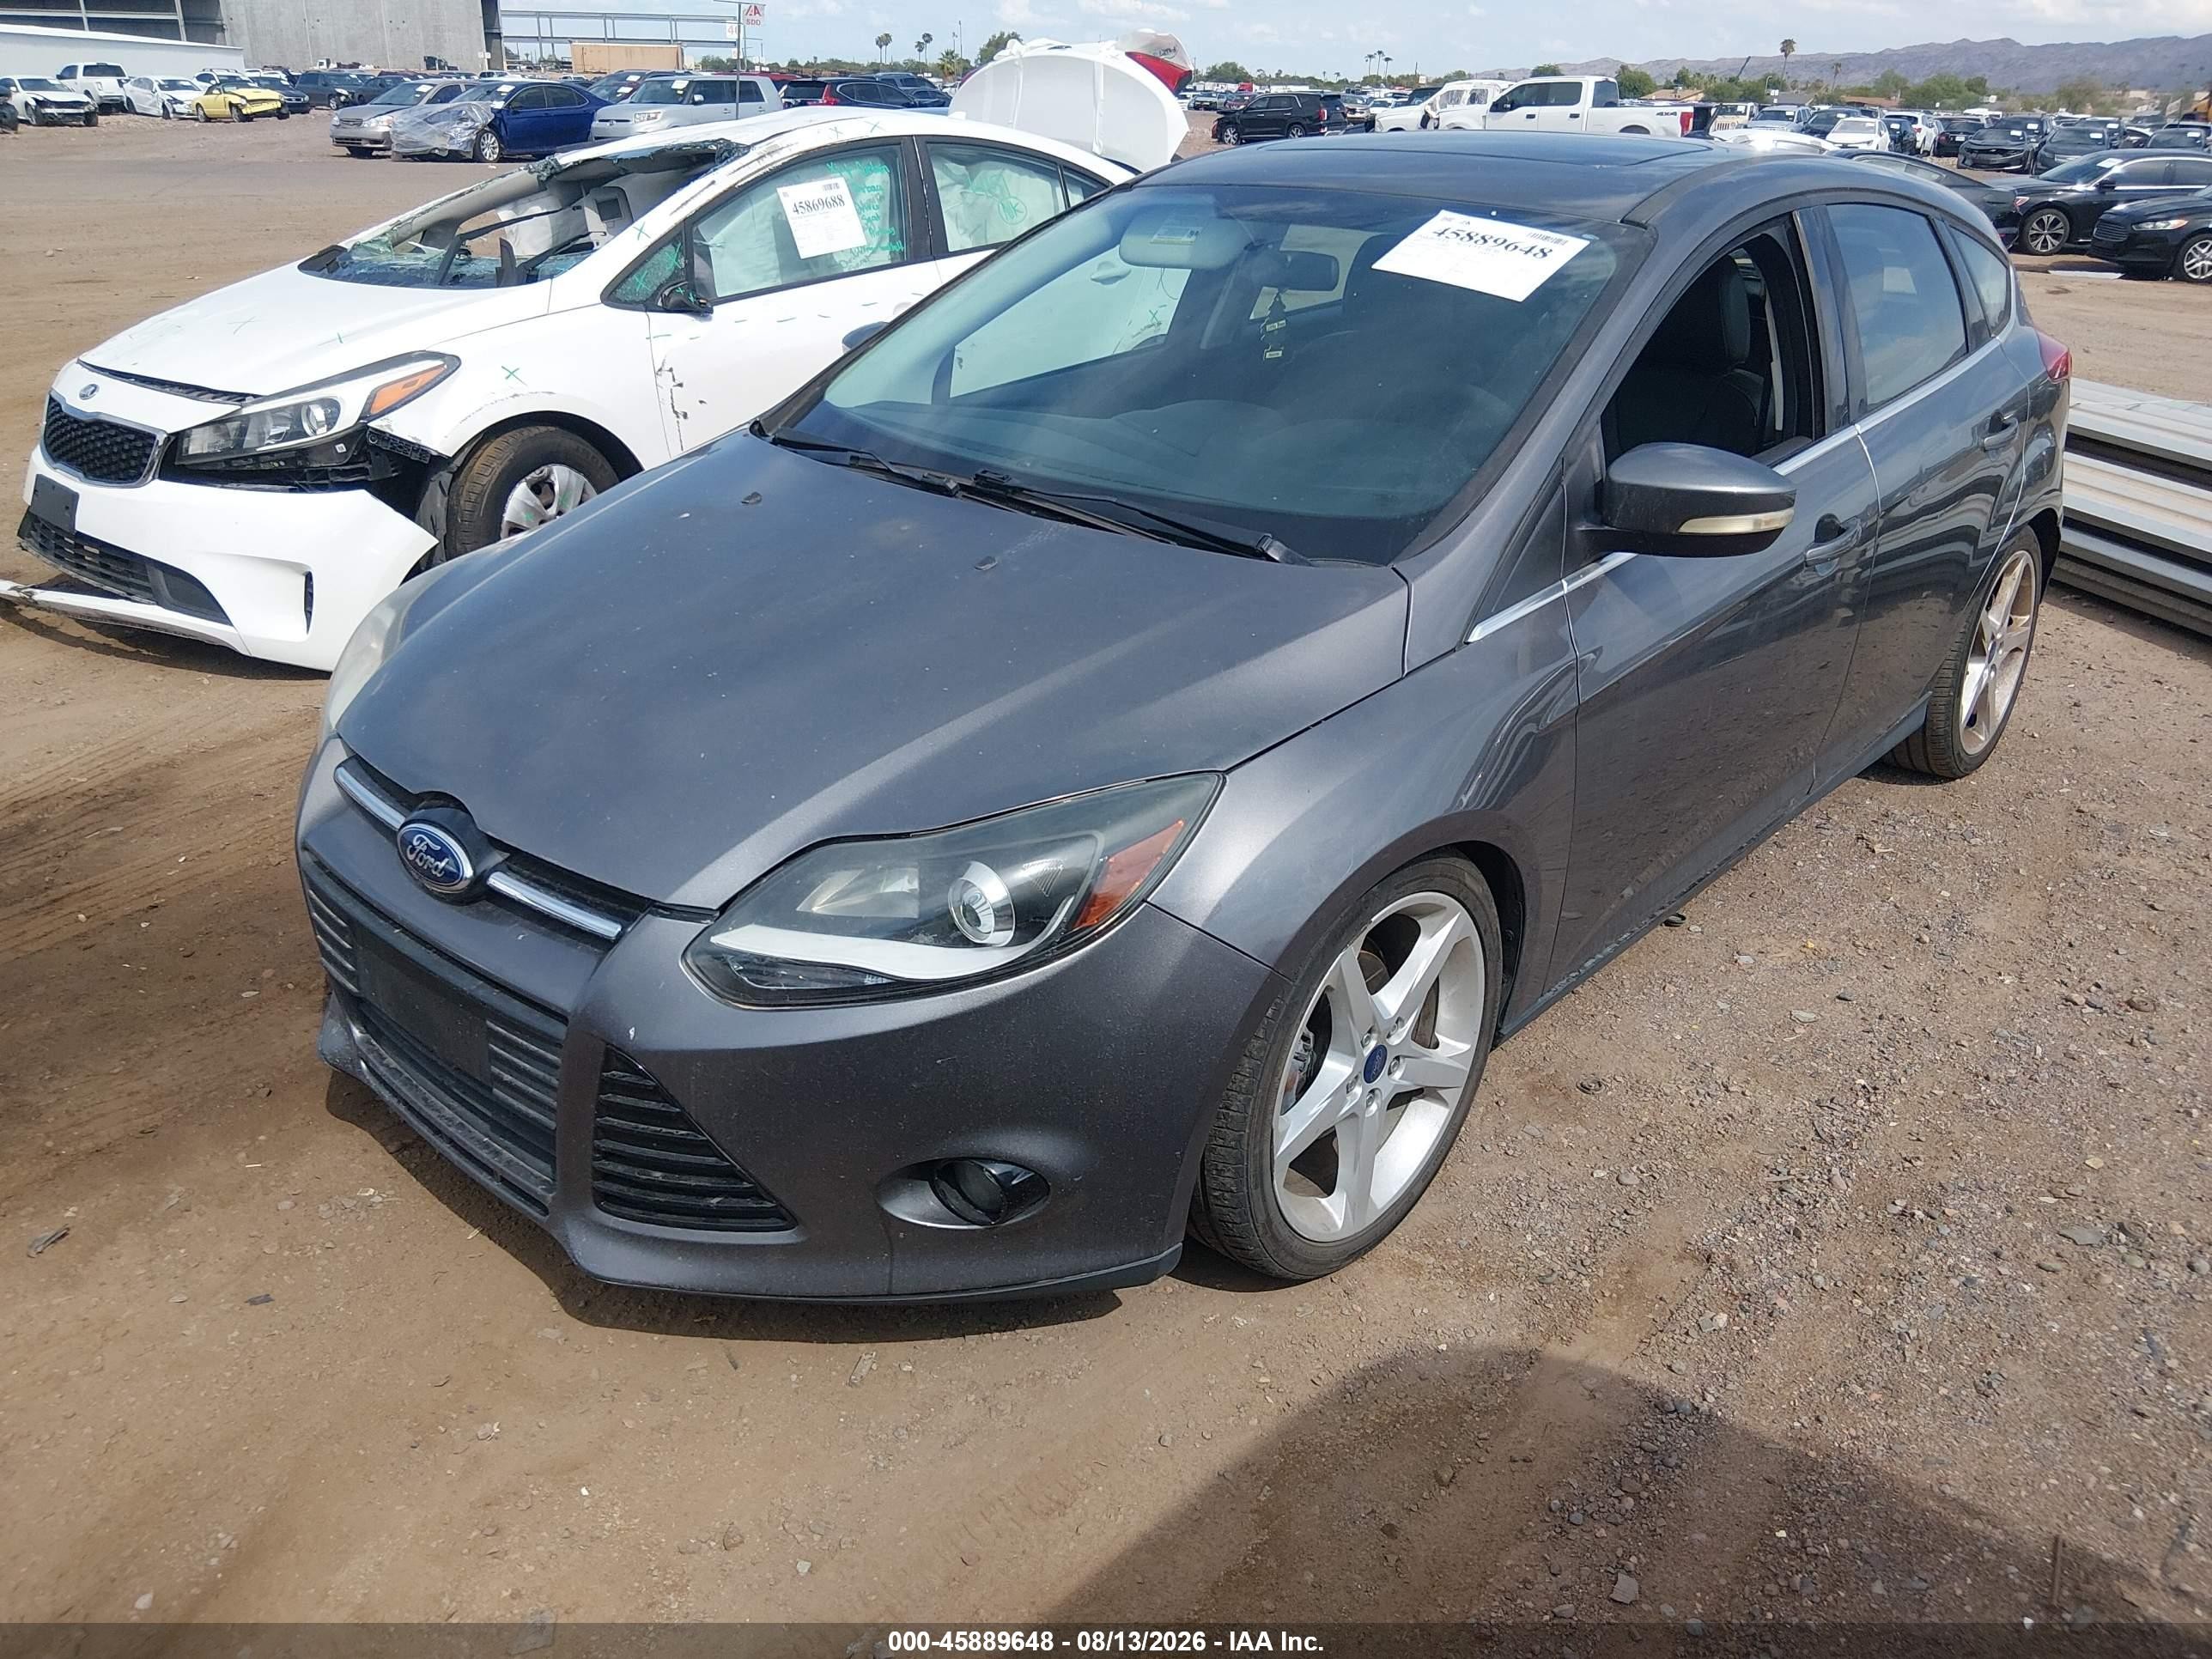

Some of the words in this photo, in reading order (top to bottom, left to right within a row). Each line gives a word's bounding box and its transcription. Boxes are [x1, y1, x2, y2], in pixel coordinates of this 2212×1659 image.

[792, 194, 846, 216] 45869688
[1433, 227, 1553, 259] 45889648
[406, 834, 453, 878] Ford
